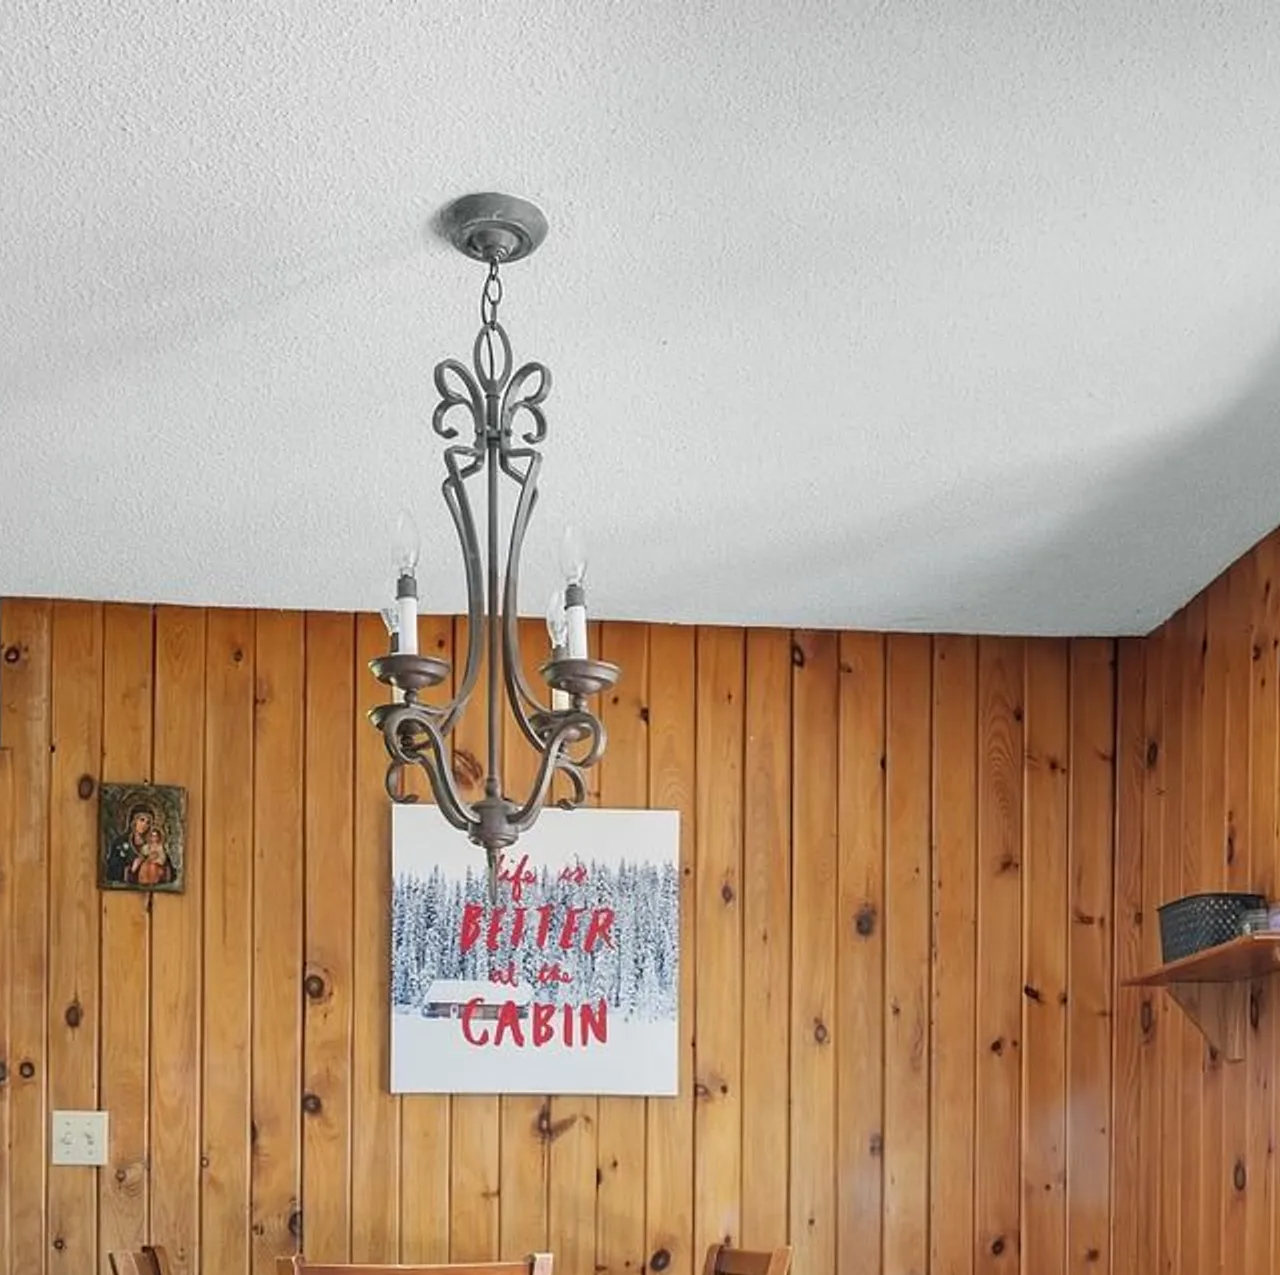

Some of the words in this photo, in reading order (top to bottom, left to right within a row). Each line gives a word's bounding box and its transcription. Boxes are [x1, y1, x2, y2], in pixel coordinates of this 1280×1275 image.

[459, 902, 616, 955] BETTER
[538, 962, 573, 984] the
[461, 997, 608, 1047] CABIN
